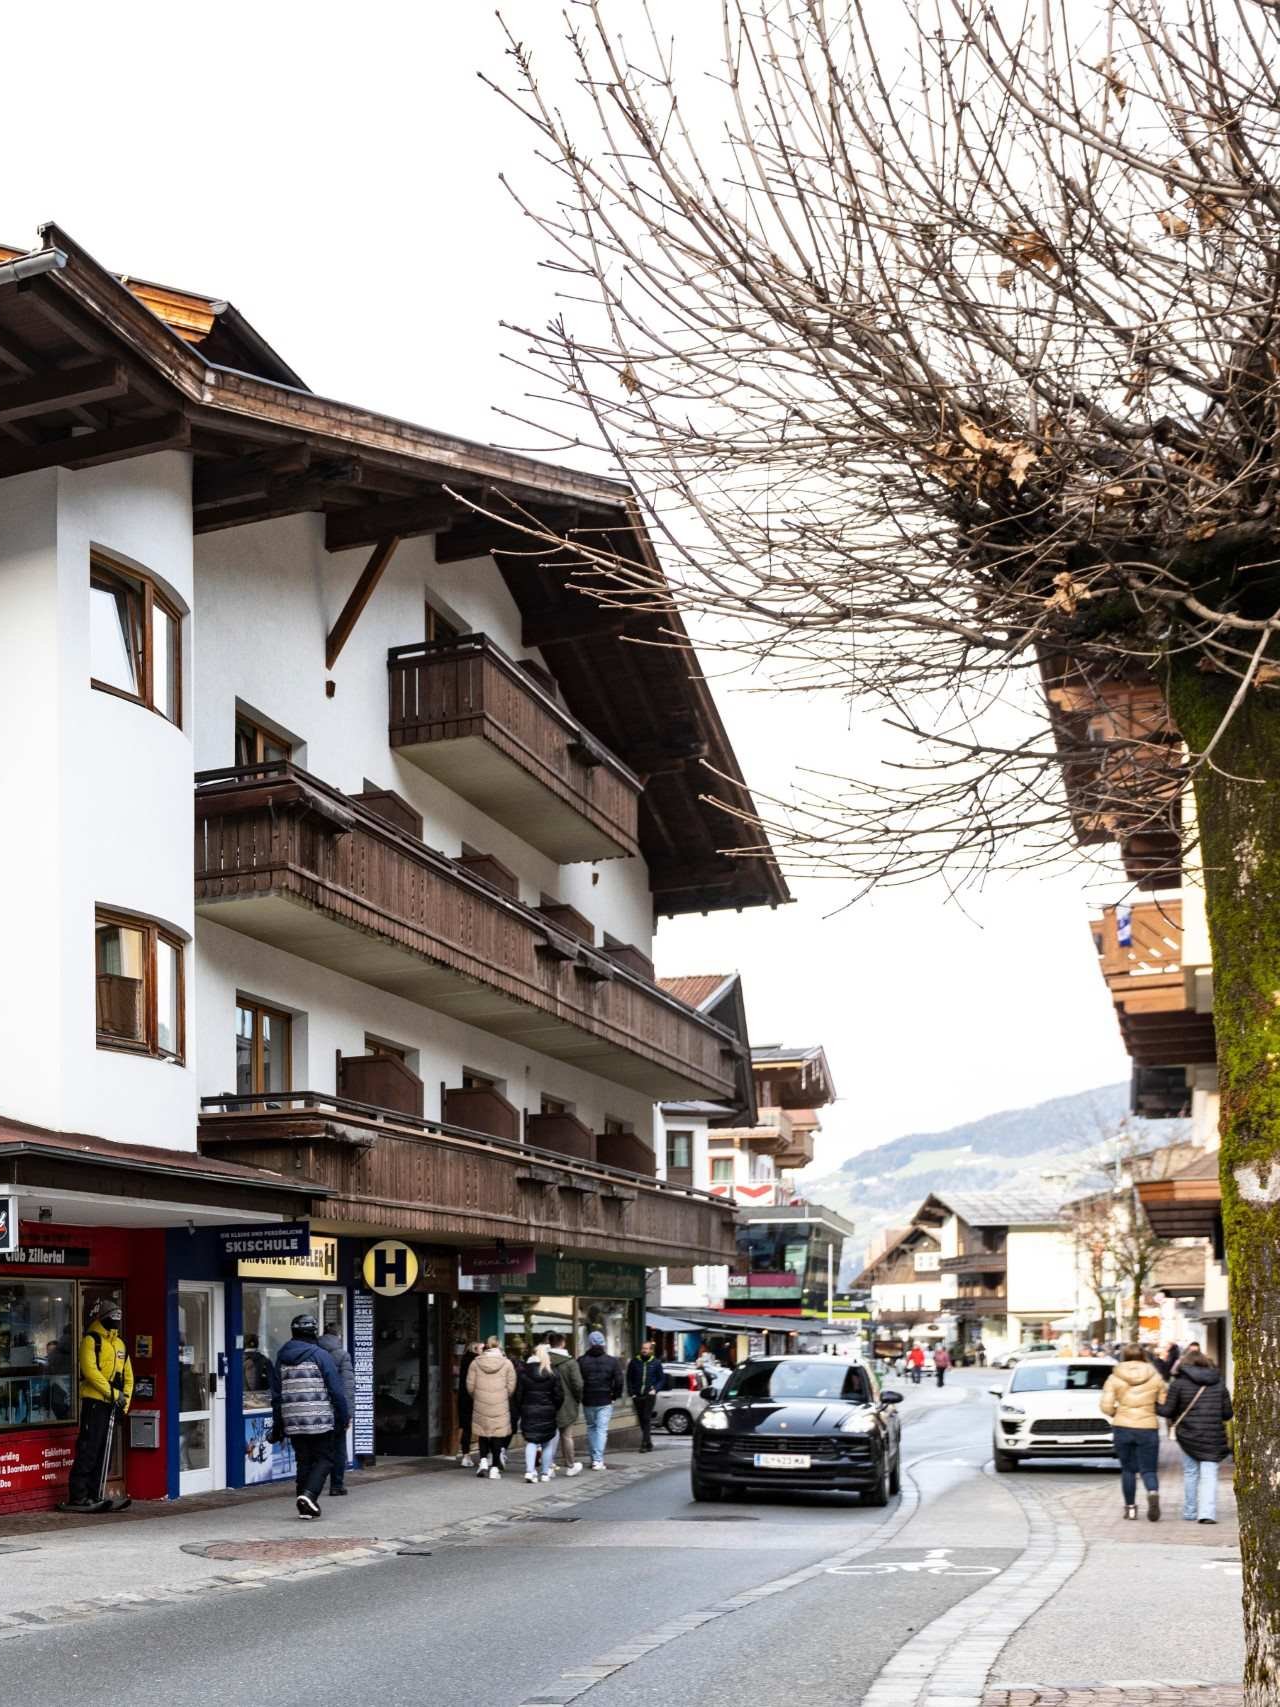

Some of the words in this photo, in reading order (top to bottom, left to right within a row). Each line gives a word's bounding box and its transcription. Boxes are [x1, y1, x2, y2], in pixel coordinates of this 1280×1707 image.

[225, 1238, 299, 1253] SKISCHULE
[28, 1248, 65, 1264] Zillertal
[374, 1249, 408, 1288] H
